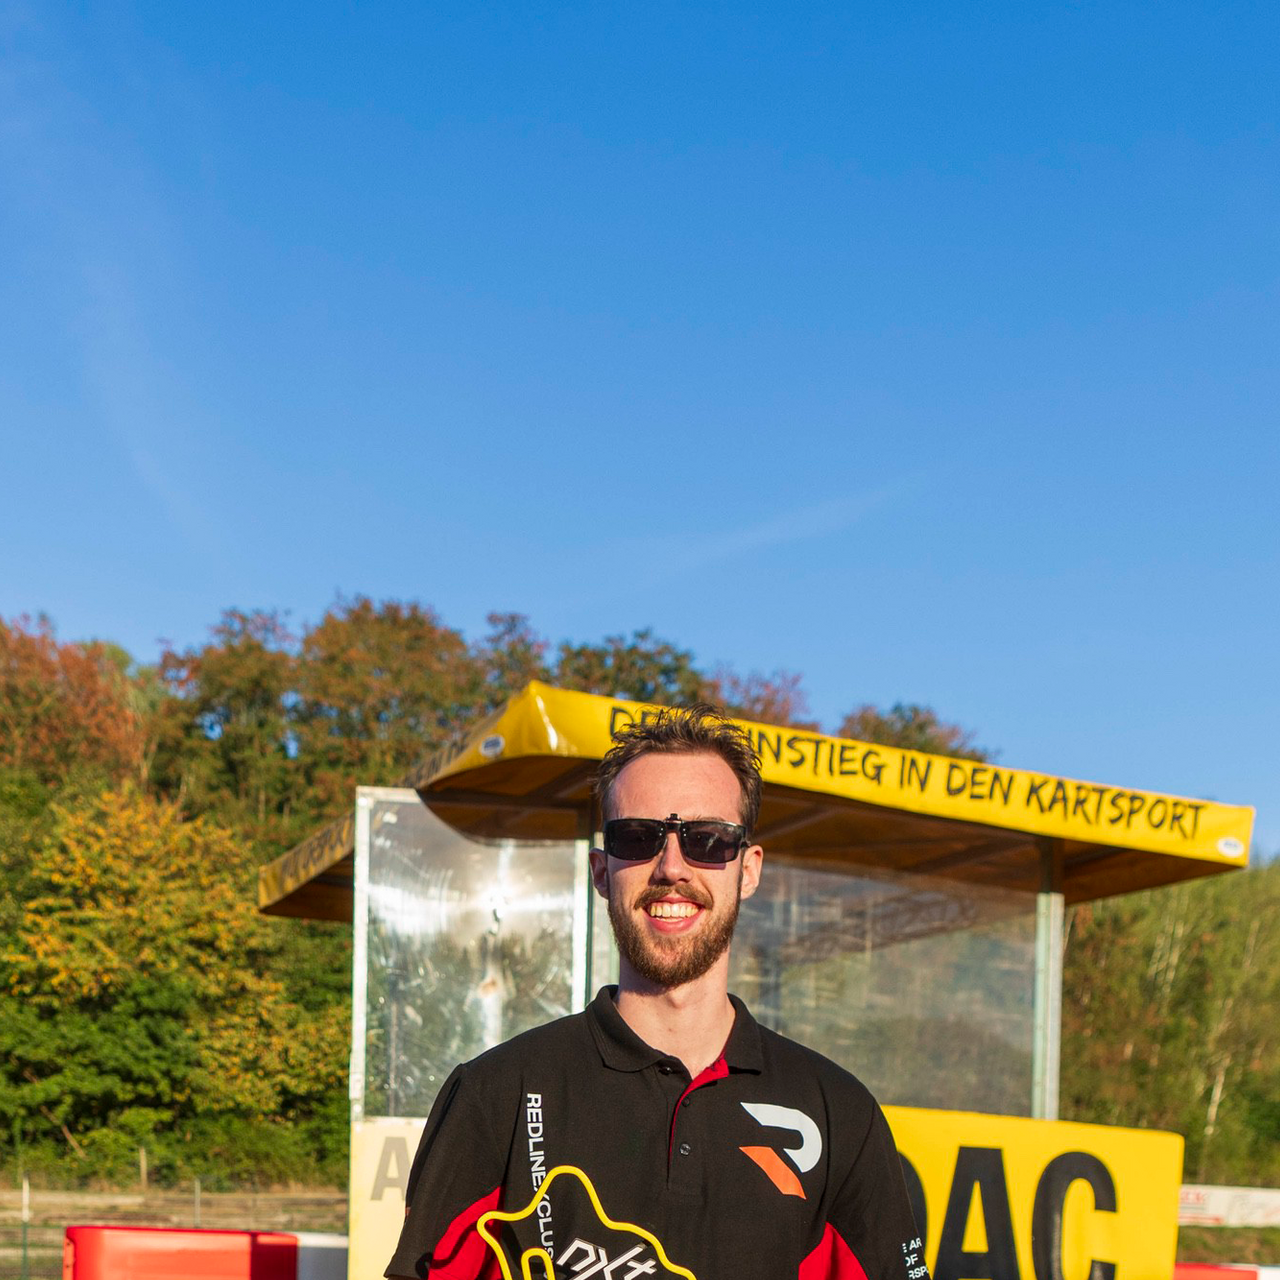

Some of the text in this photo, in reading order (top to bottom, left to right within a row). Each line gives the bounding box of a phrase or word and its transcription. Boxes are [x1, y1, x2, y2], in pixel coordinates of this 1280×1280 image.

[899, 754, 932, 796] IN
[947, 760, 1014, 808] DEN
[1026, 777, 1206, 841] KARTSPORT
